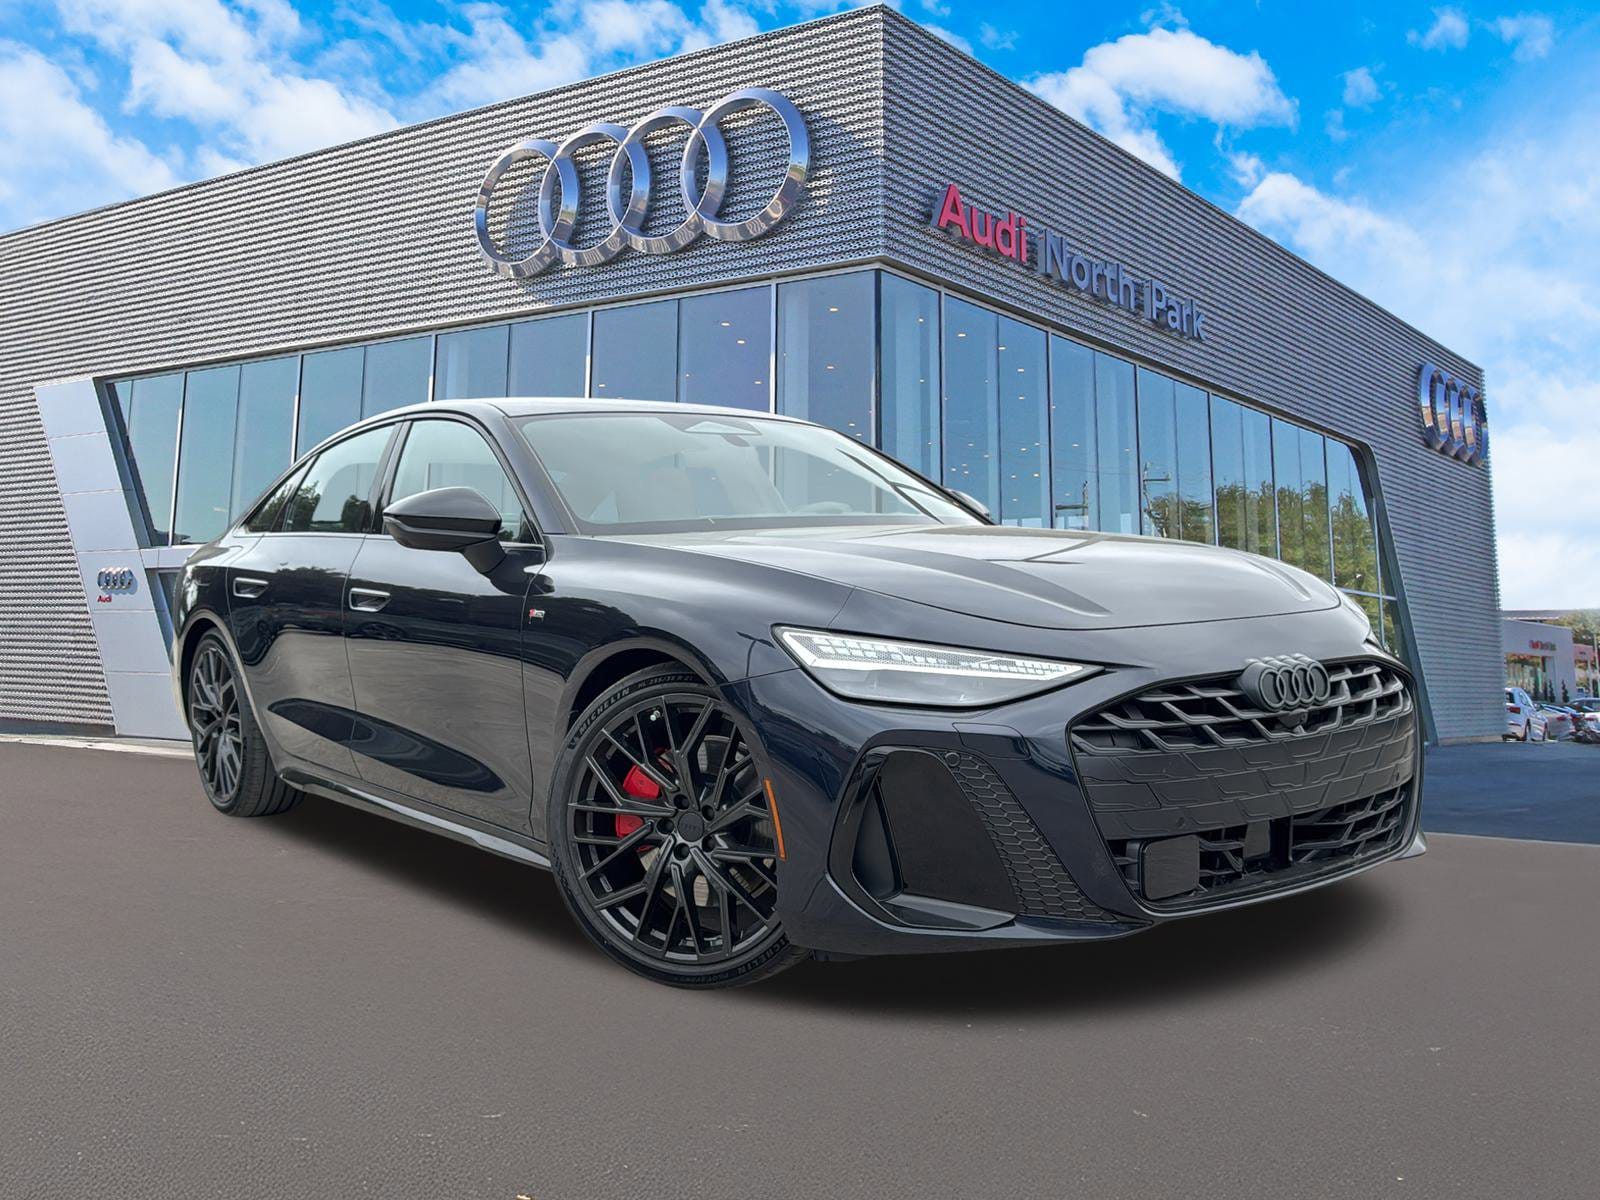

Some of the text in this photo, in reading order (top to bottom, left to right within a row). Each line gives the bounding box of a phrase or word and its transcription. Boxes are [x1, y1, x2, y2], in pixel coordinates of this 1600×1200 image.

[937, 183, 1208, 341] Audi North Park
[579, 688, 629, 735] MICHELIN
